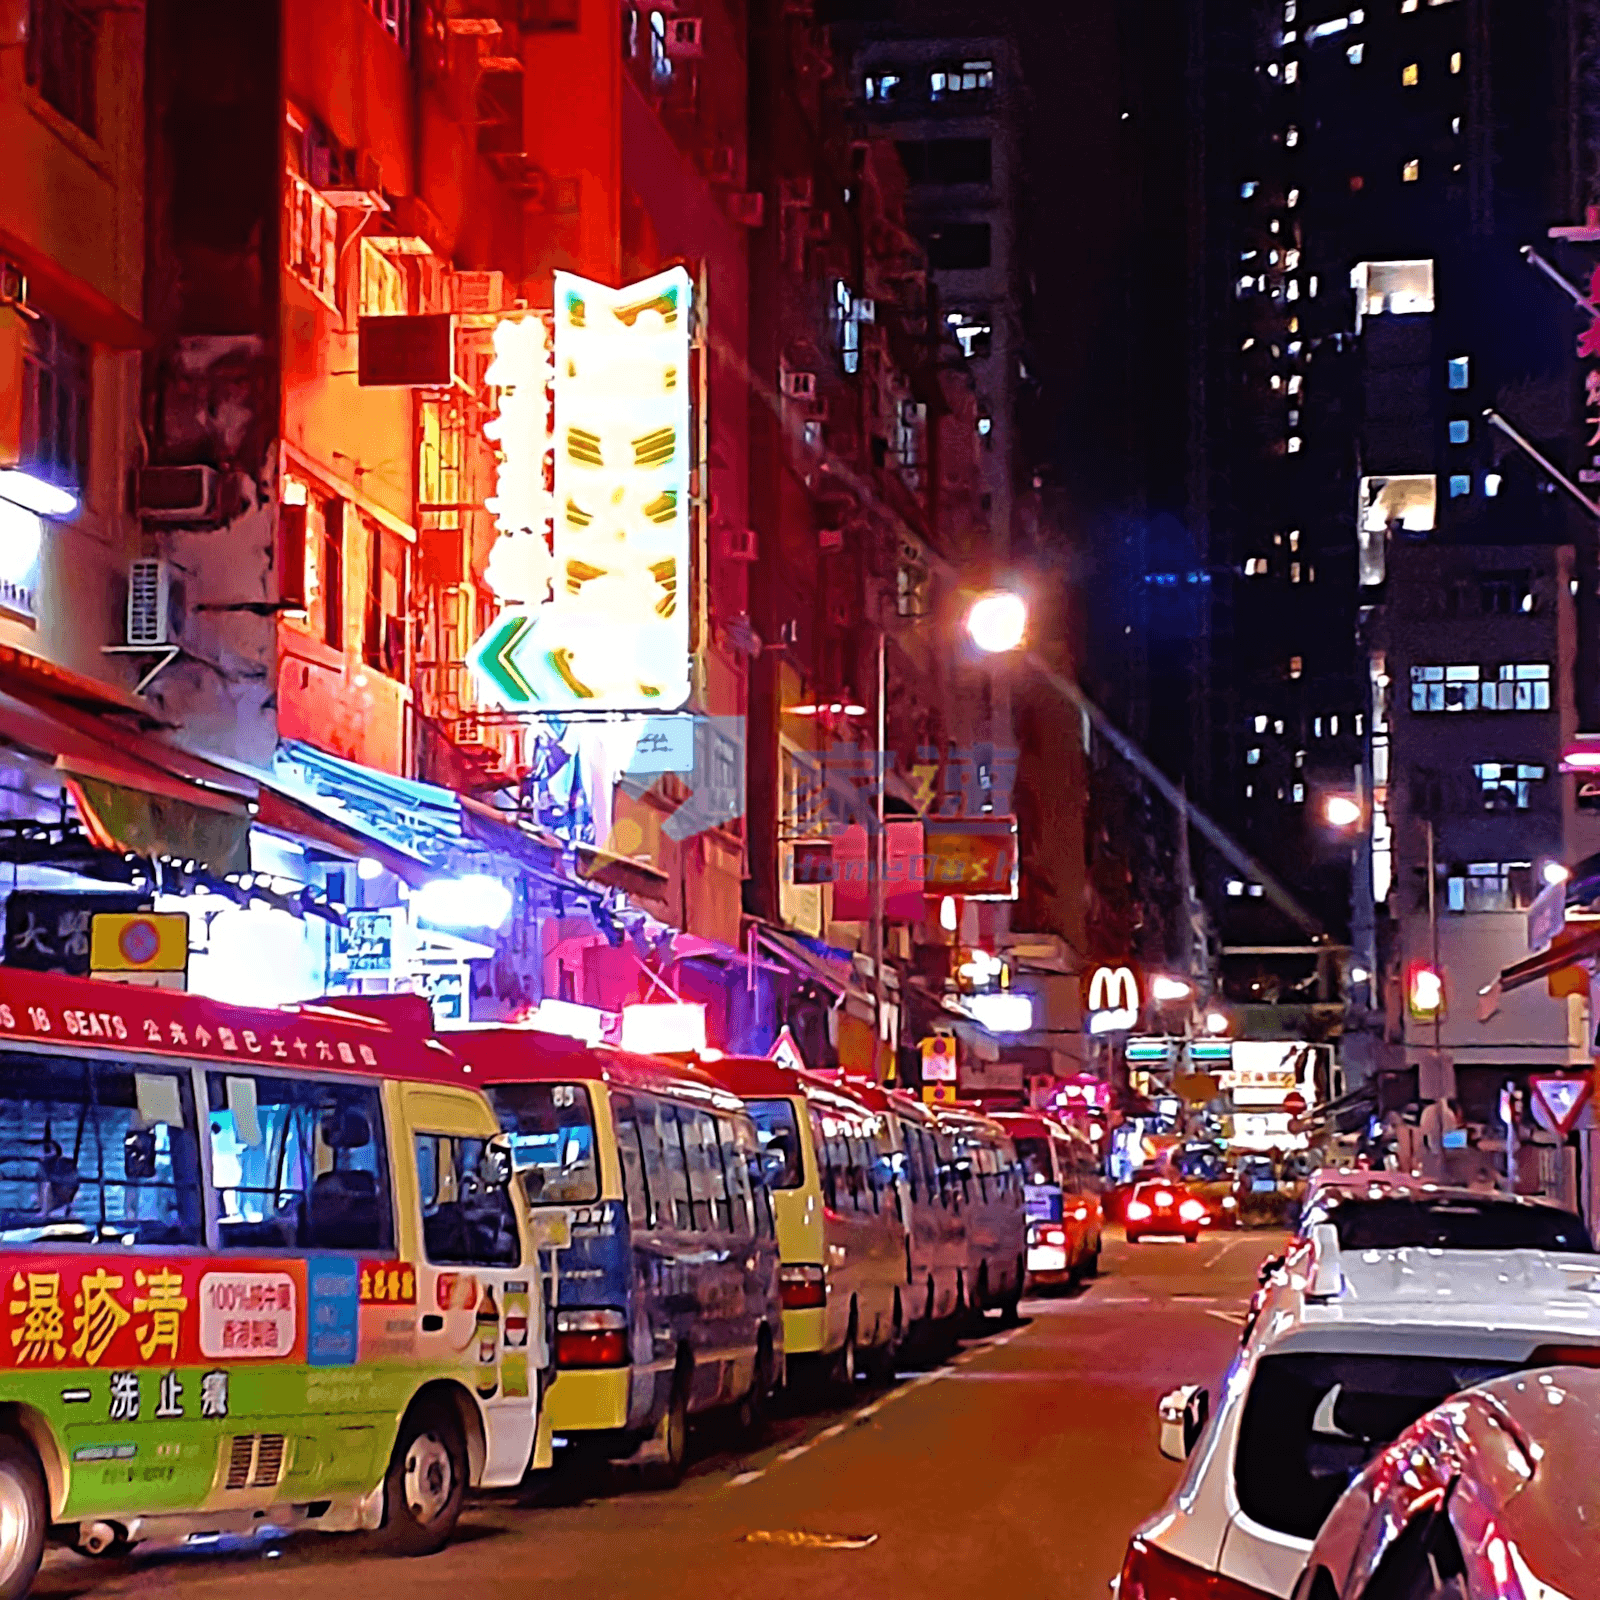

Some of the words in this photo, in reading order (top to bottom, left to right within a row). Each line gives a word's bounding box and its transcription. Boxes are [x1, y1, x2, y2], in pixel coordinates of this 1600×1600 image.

[63, 1010, 127, 1039] SEATS
[10, 1267, 188, 1366] 濕疹清
